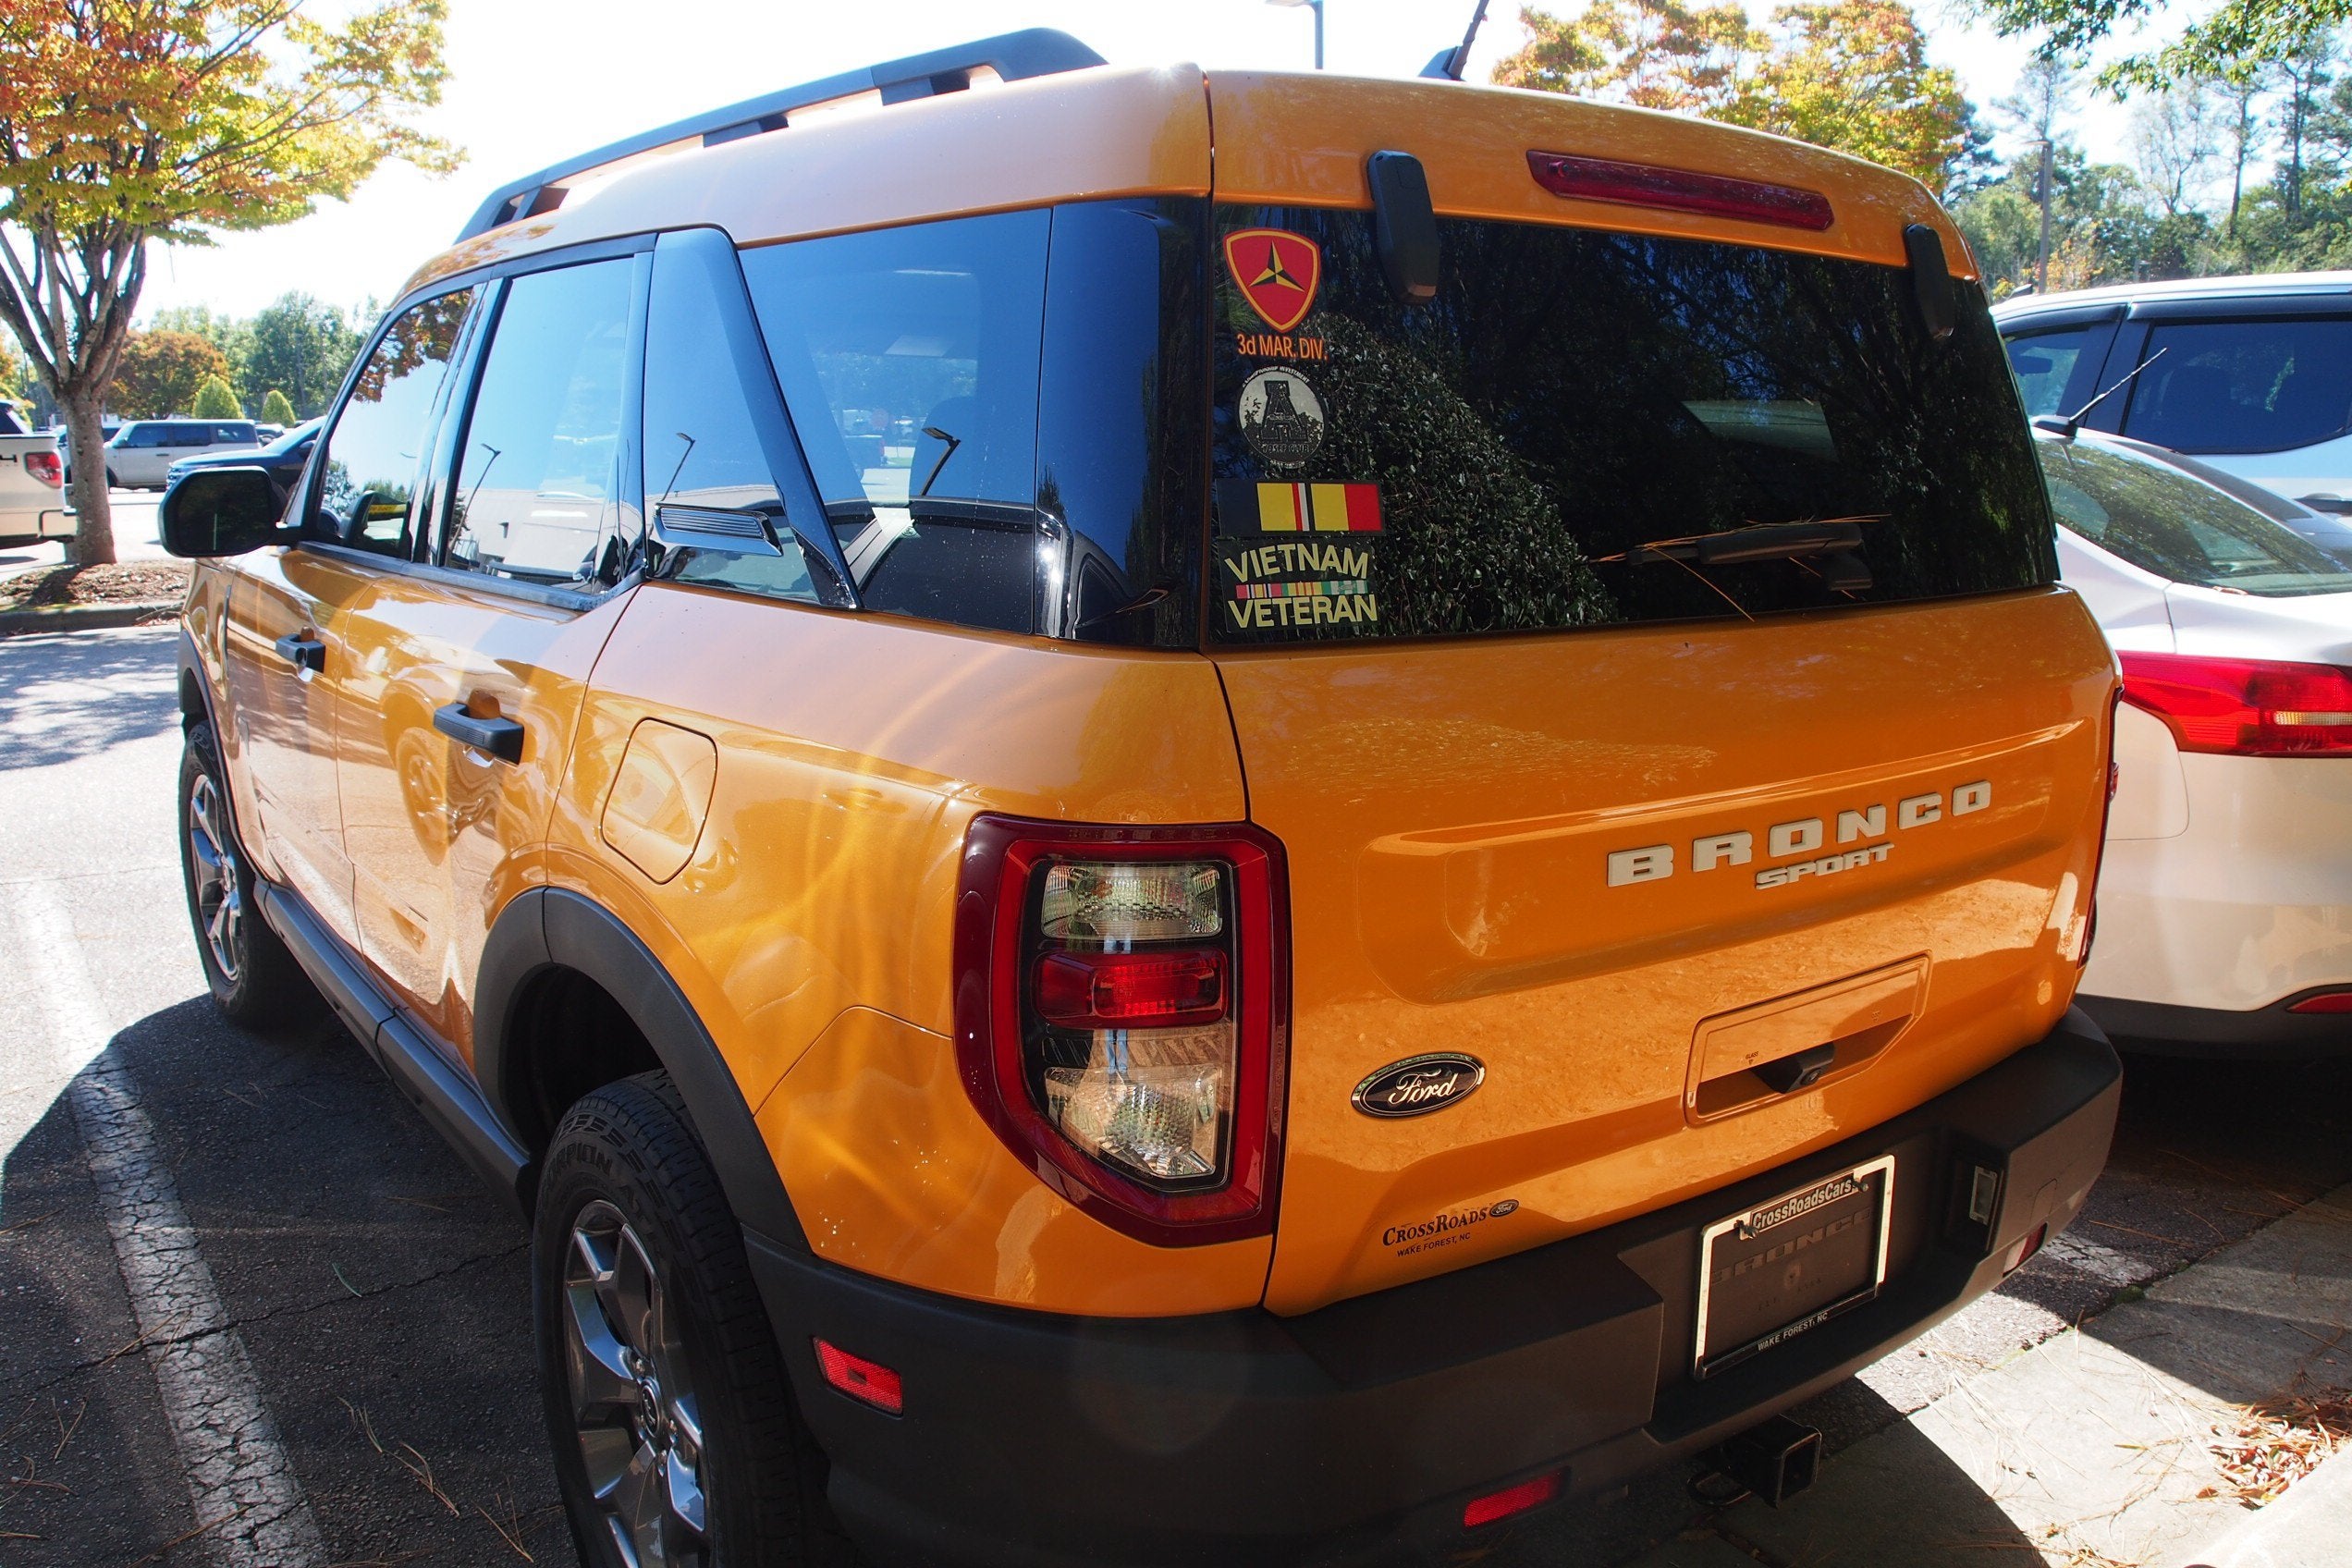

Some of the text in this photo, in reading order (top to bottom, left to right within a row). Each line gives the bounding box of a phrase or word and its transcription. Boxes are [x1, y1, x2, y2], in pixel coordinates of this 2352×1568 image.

[1237, 333, 1257, 355] 3d
[1259, 335, 1296, 358] MAR.
[1280, 366, 1310, 384] INVESTMENT
[1224, 543, 1369, 583] VIETNAM
[1228, 594, 1378, 628] VETERAN
[1607, 779, 1991, 888] BRONCO
[1756, 842, 1895, 890] SPORT
[1388, 1068, 1458, 1105] Ford
[1396, 1231, 1471, 1257] WAKE FOREST, NC
[1758, 1335, 1781, 1352] WAKE
[1817, 1312, 1828, 1323] NC
